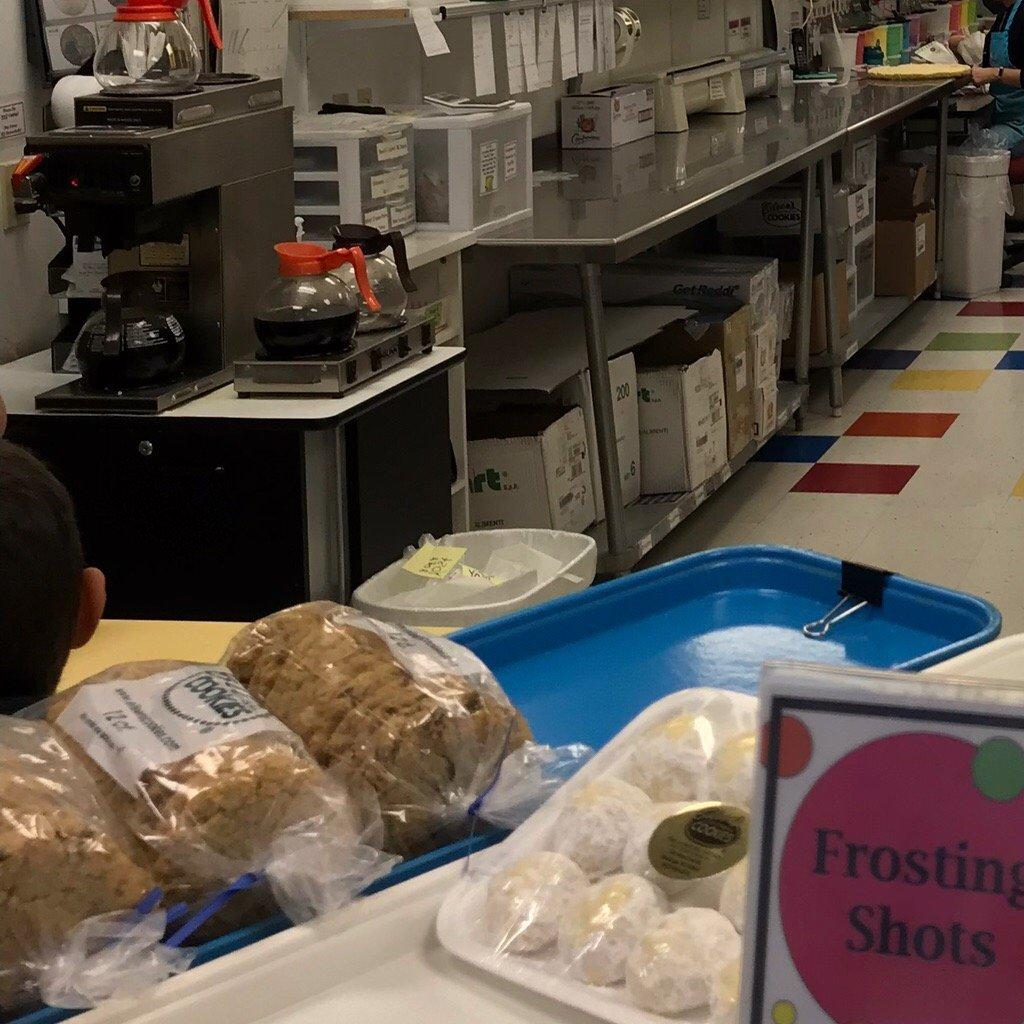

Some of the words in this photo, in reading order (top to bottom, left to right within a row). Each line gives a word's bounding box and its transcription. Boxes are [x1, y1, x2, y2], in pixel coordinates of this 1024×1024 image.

[616, 383, 630, 401] 200
[185, 675, 242, 719] COOKIES
[846, 904, 997, 969] Shots
